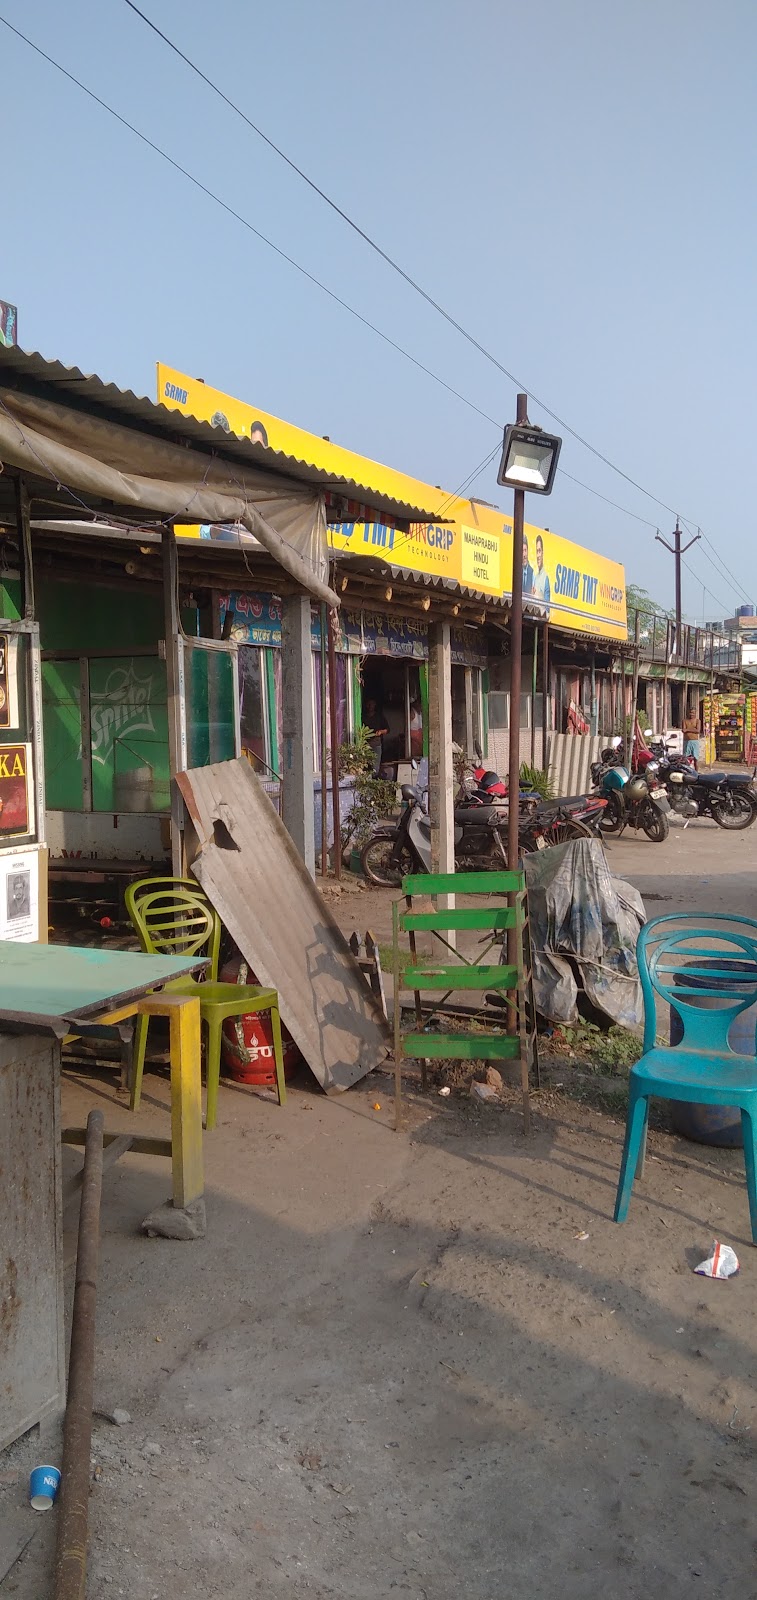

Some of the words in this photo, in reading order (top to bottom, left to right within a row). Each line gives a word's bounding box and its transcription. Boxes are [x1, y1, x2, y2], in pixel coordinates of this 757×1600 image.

[164, 381, 188, 405] SRMB
[463, 531, 498, 553] MAHAPRABHU
[407, 545, 450, 563] TECHNOLOGY
[473, 551, 489, 565] HINDU
[473, 567, 489, 581] HOTEL
[554, 563, 581, 599] SRMB
[582, 573, 599, 605] TMT
[599, 581, 624, 604] WINGRIP
